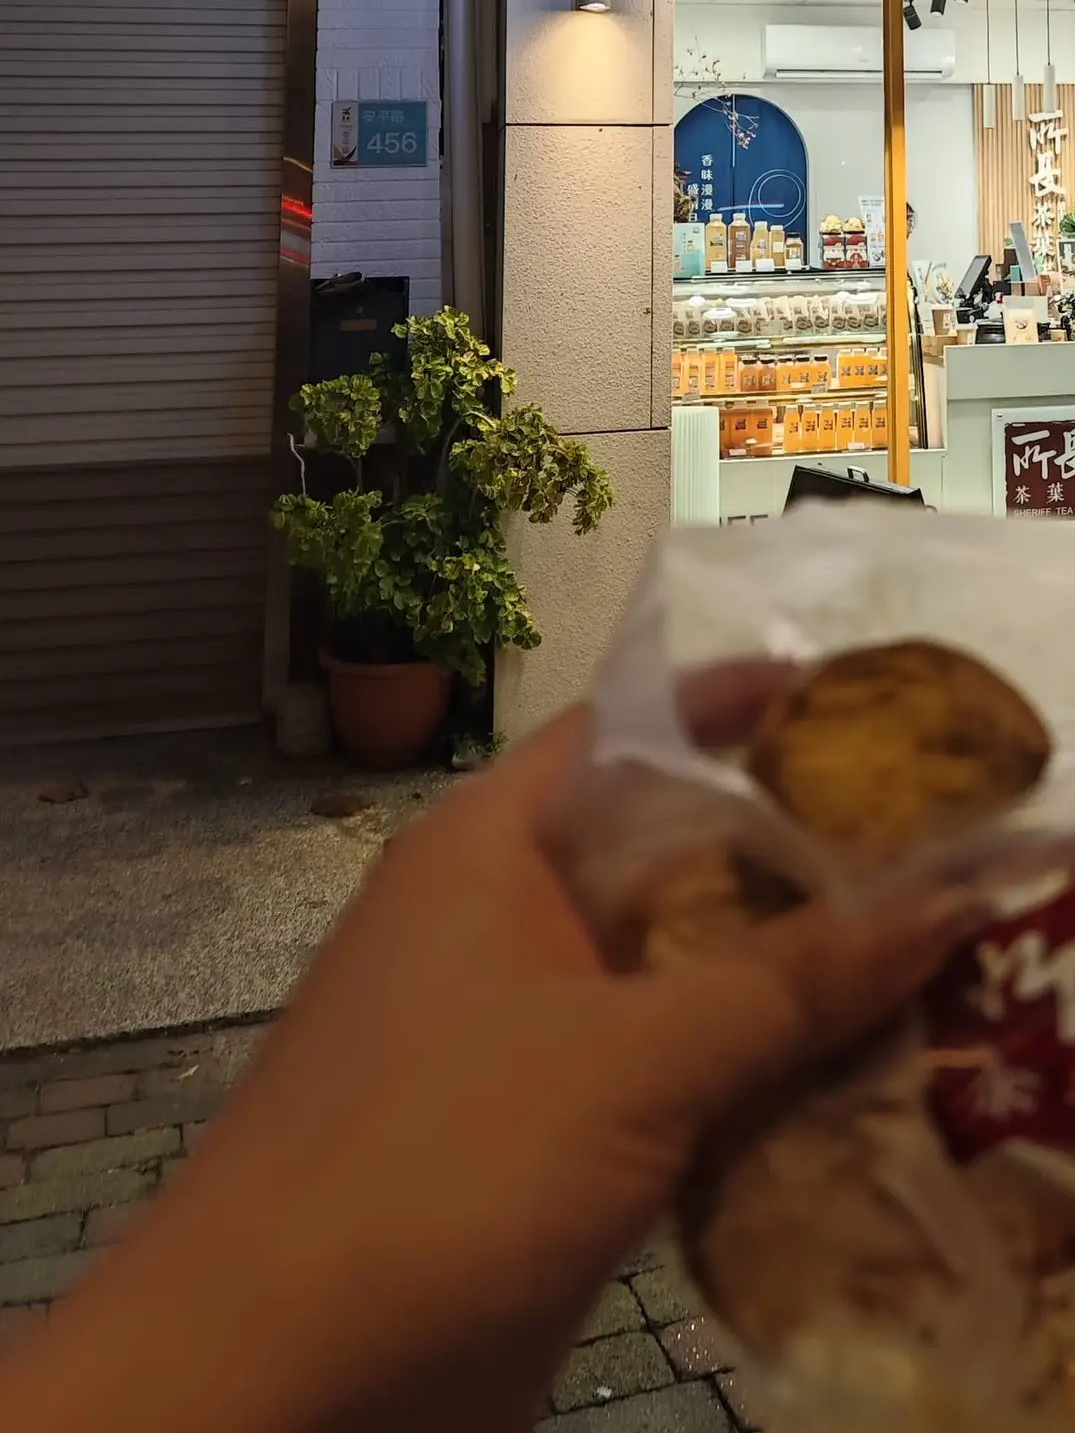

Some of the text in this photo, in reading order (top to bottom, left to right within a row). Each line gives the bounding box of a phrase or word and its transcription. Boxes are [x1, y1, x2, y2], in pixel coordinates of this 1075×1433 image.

[366, 131, 418, 154] 456
[701, 154, 714, 212] 香味漫漫
[1056, 506, 1074, 515] TEA
